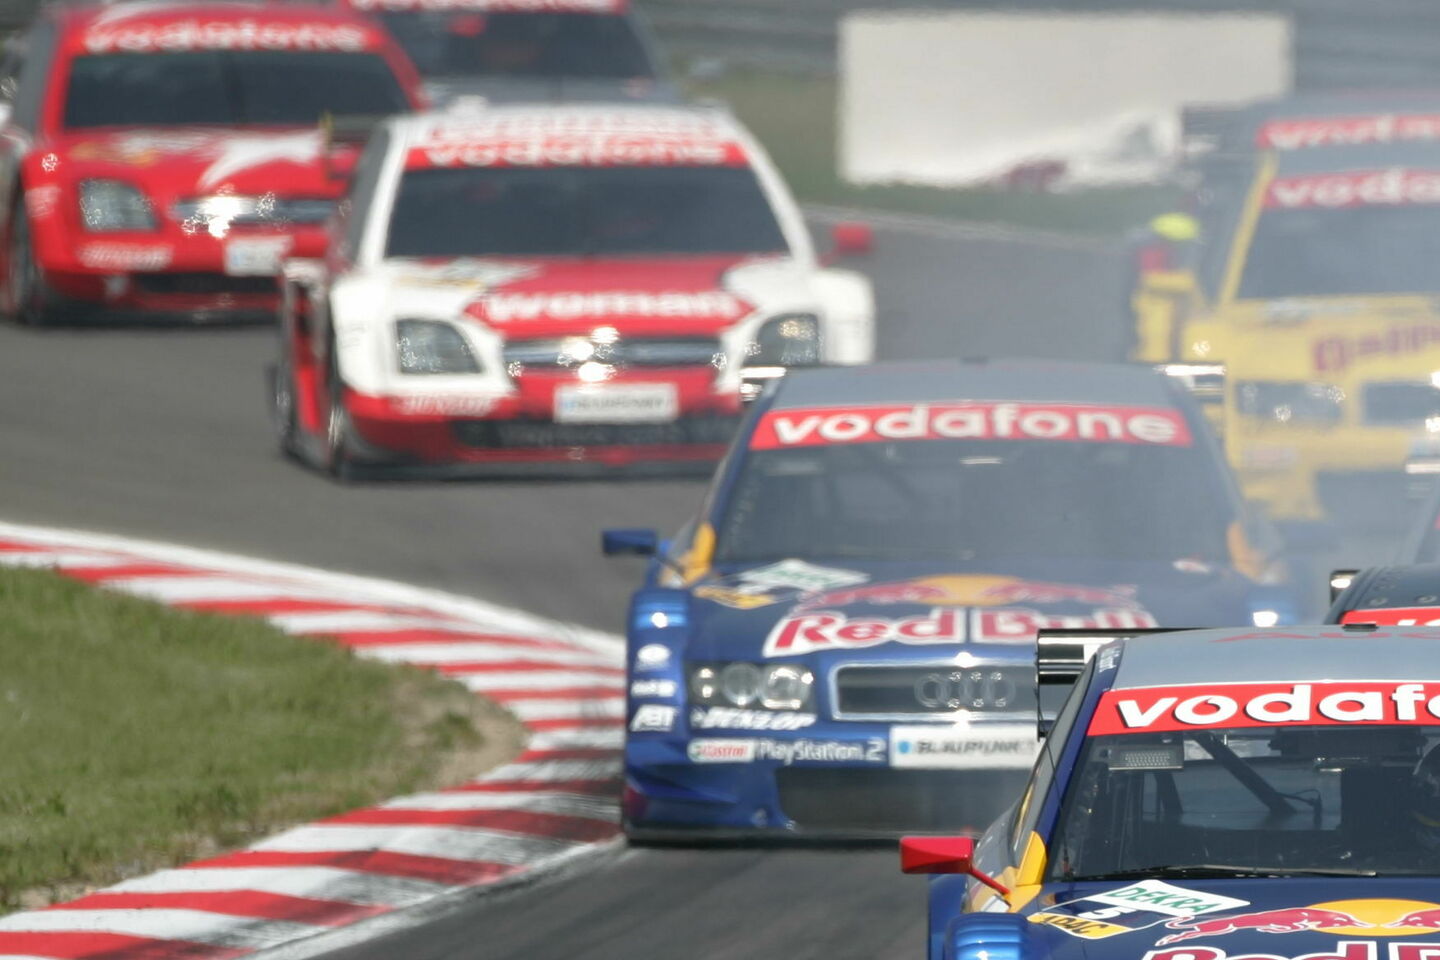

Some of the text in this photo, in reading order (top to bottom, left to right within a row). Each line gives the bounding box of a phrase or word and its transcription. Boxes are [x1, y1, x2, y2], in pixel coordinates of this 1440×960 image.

[772, 404, 1179, 446] vodafone
[763, 606, 968, 657] Red
[1104, 886, 1222, 913] DEKRA
